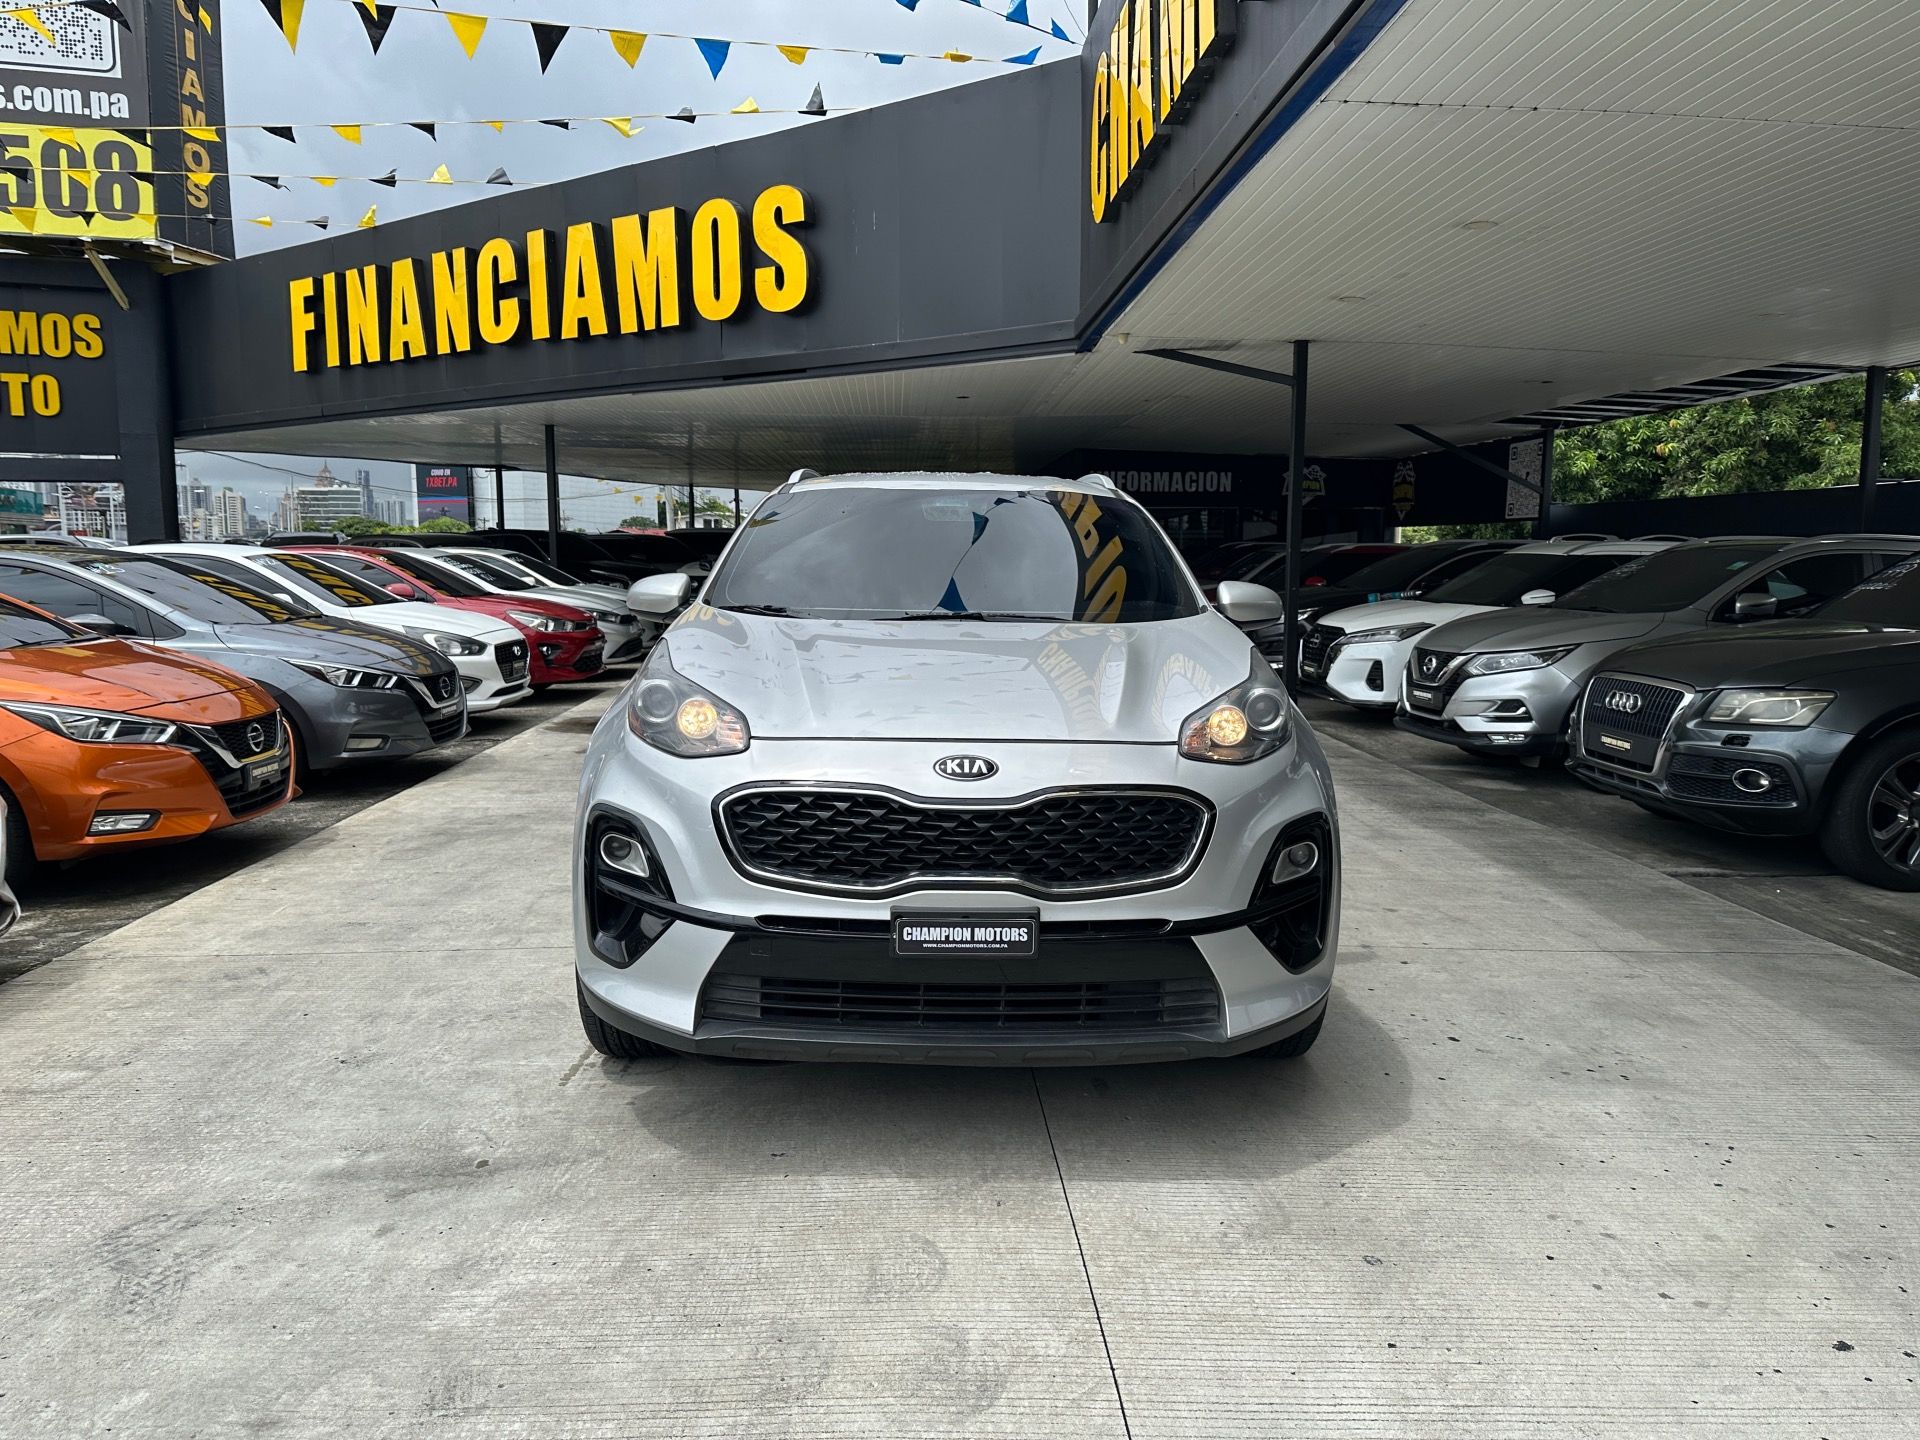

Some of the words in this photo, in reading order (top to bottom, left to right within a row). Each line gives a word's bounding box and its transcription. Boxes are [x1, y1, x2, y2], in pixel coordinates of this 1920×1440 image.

[290, 185, 808, 373] FINANCIAMOS
[0, 310, 104, 359] MOS
[0, 373, 61, 416] TO
[946, 759, 988, 774] KIA
[903, 926, 972, 941] CHAMPION
[974, 927, 1028, 942] MOTORS
